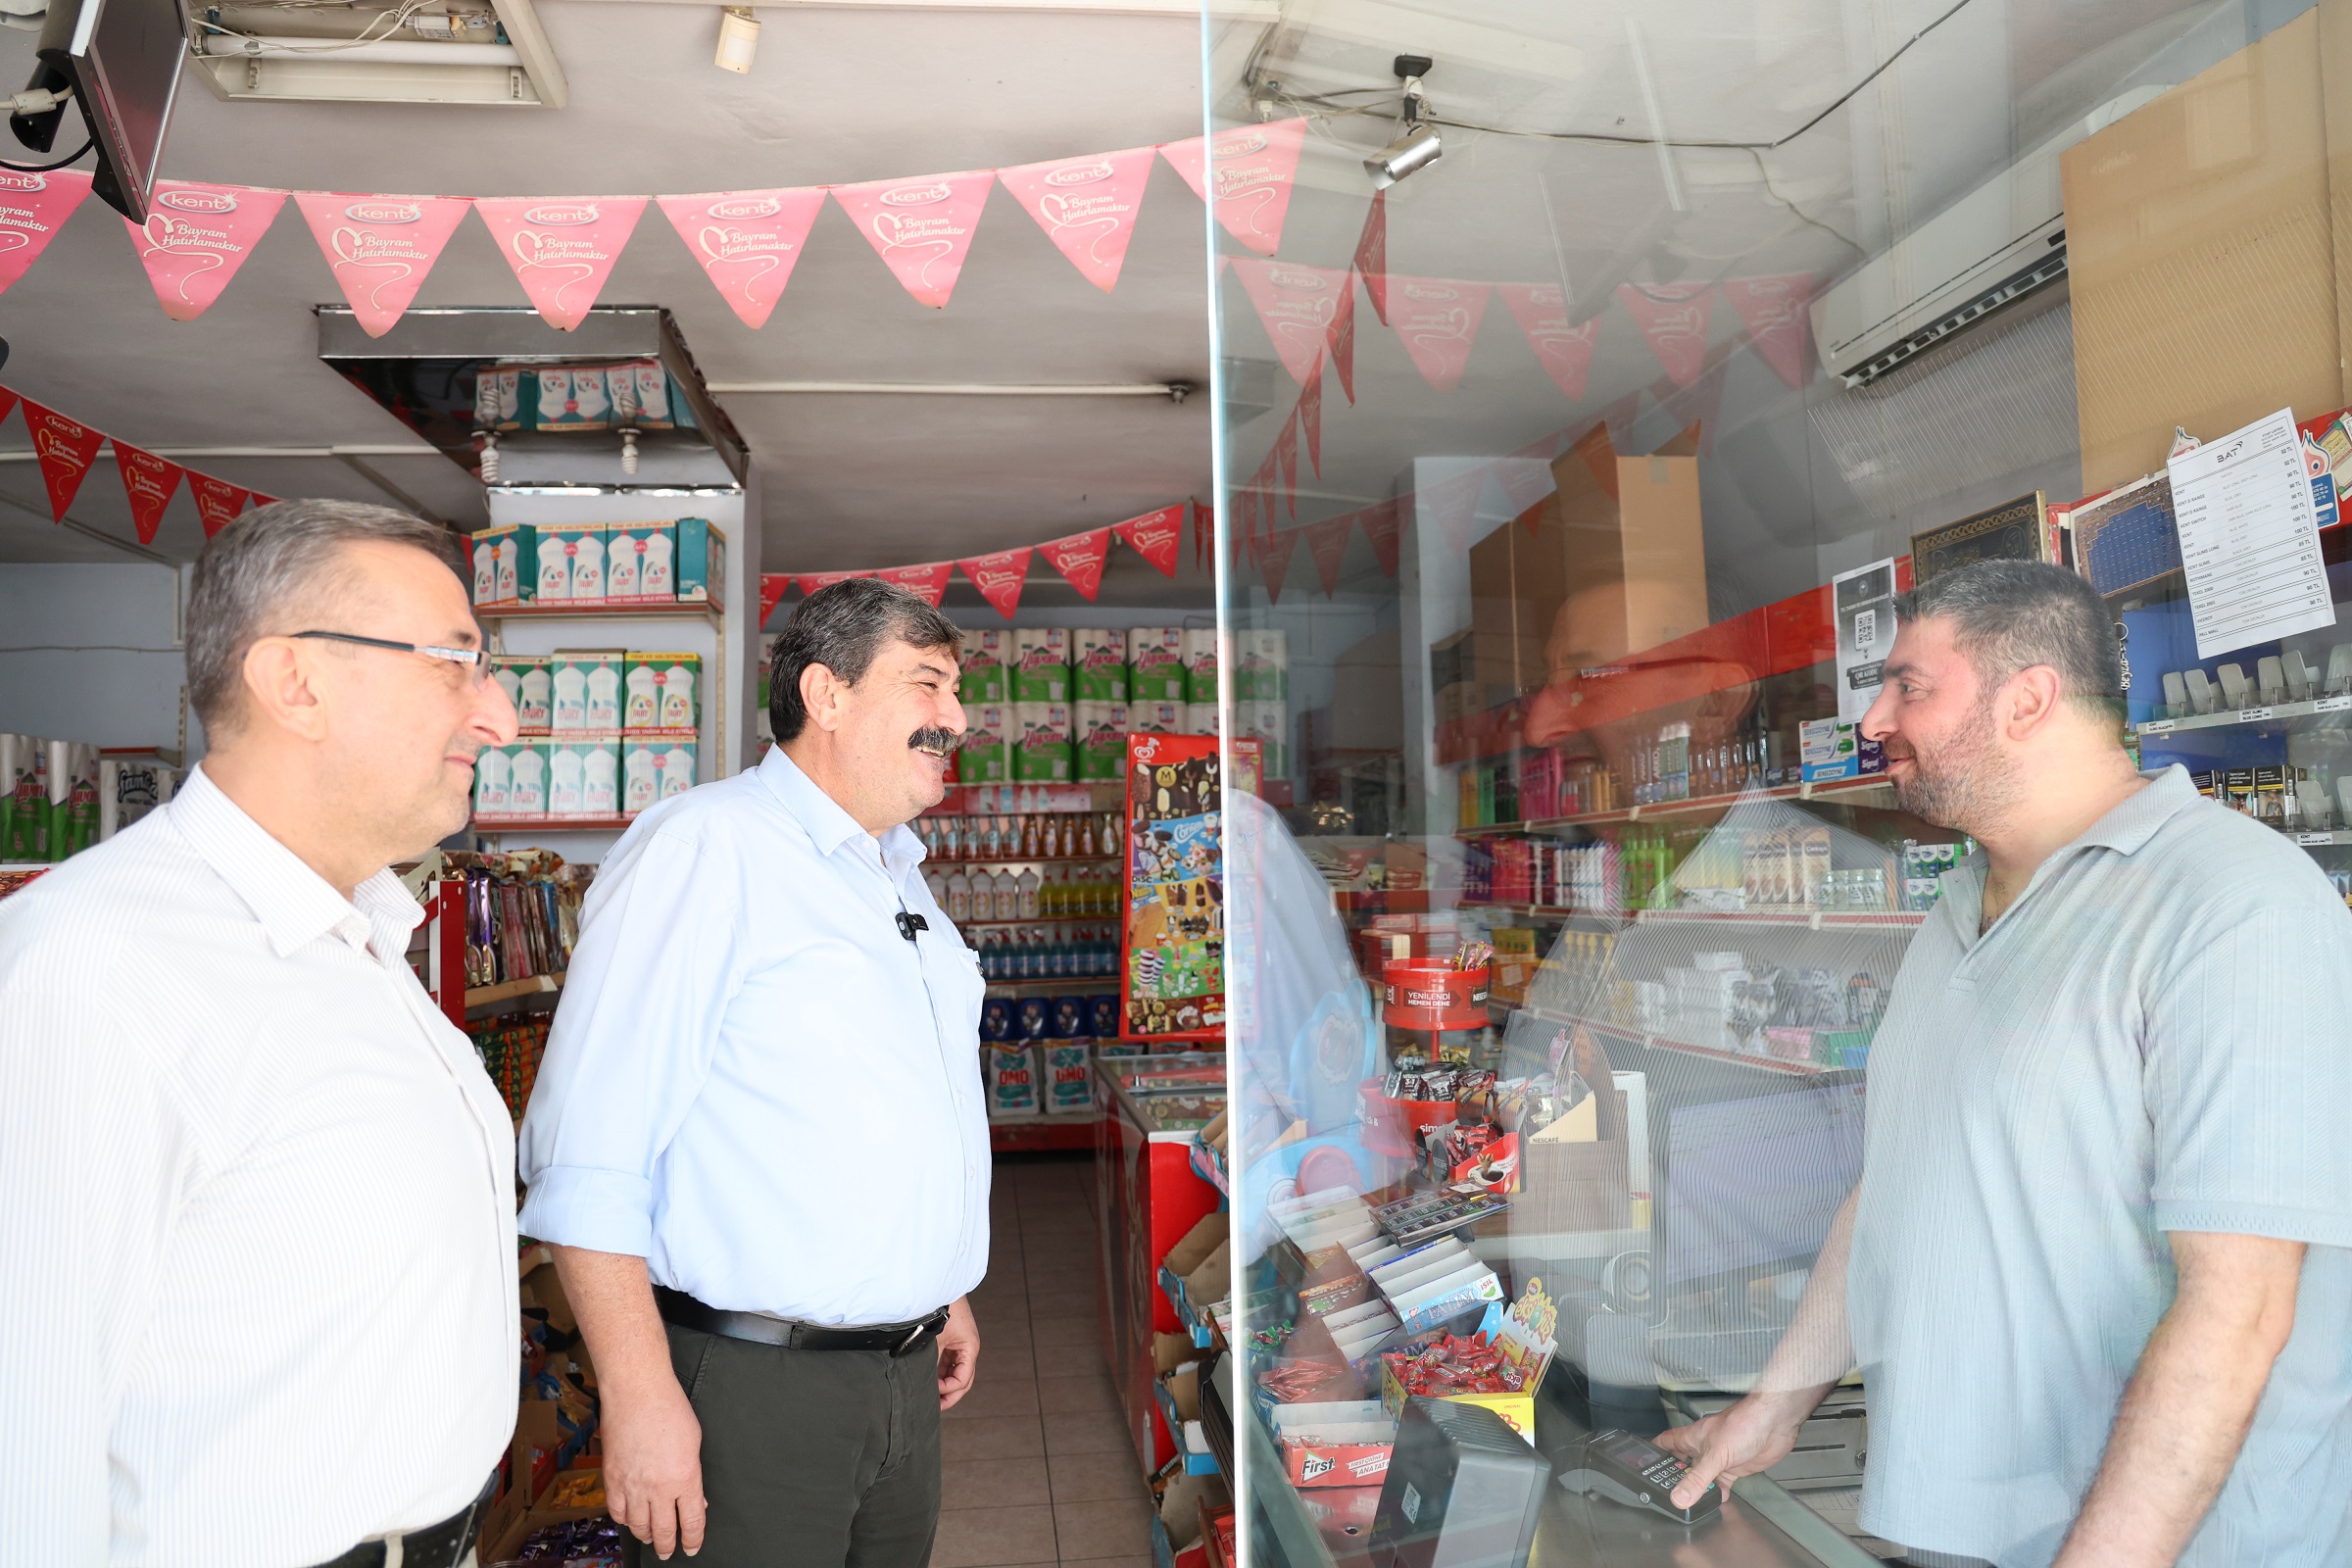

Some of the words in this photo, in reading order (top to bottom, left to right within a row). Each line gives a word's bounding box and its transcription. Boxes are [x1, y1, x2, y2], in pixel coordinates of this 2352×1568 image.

[1211, 137, 1260, 156] kent
[0, 173, 36, 189] ent
[1054, 166, 1104, 183] kent
[1225, 165, 1270, 182] Bayram
[172, 194, 226, 210] kent
[892, 187, 942, 203] kent
[1068, 193, 1114, 209] Bayram
[0, 206, 34, 219] yram
[358, 206, 411, 220] kent
[536, 209, 589, 221] kent
[719, 202, 770, 216] kent
[1061, 203, 1130, 222] Hatırlamaktır
[0, 216, 49, 232] lamaktır
[903, 216, 950, 228] Bayram
[177, 223, 227, 239] Bayram
[730, 230, 777, 243] Bayram
[895, 225, 966, 242] Hatırlamaktır
[163, 234, 243, 253] Hatırlamaktır
[365, 235, 414, 249] Bayram
[545, 237, 594, 250] Bayram
[720, 241, 793, 256] Hatırlamaktır
[352, 247, 428, 261] Hatırlamaktır
[533, 248, 610, 262] Hatırlamaktır
[51, 417, 79, 436] kent
[1804, 725, 1830, 735] SENSODYNE
[1804, 746, 1832, 755] SENSODYNE
[1861, 741, 1880, 750] Signal
[1861, 758, 1880, 768] Signal
[1408, 991, 1450, 1000] YENİLENDİ
[999, 1069, 1029, 1085] OMO
[1426, 1291, 1476, 1320] FALIM
[1301, 1457, 1335, 1475] First
[1358, 1466, 1374, 1475] ANA
[1374, 1462, 1387, 1471] TAT
